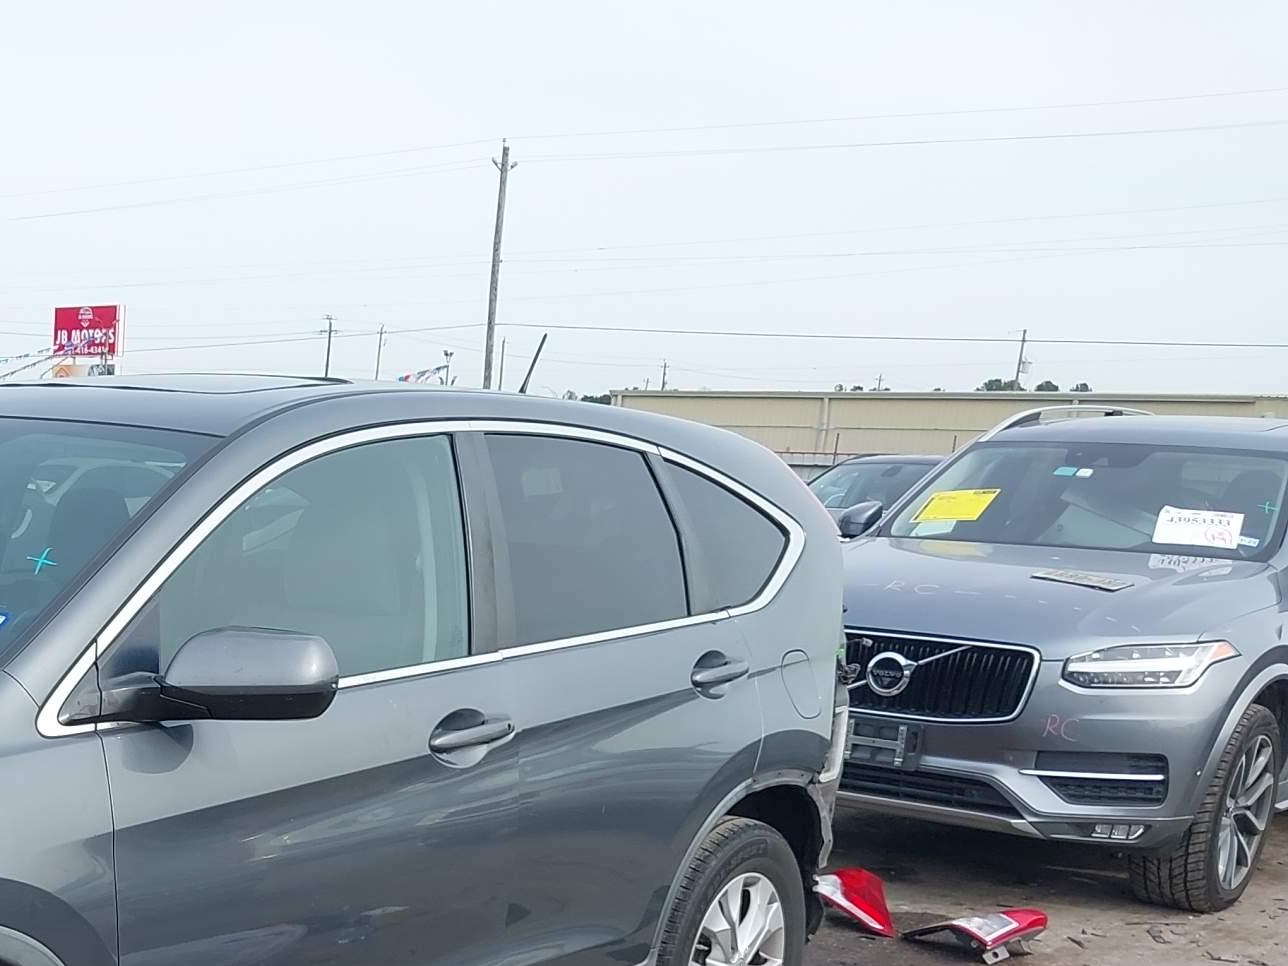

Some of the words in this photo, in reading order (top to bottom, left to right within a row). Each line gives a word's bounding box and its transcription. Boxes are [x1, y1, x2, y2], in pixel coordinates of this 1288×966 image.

[55, 328, 68, 345] JB
[872, 669, 902, 678] VOLVO
[1042, 713, 1080, 742] RC
